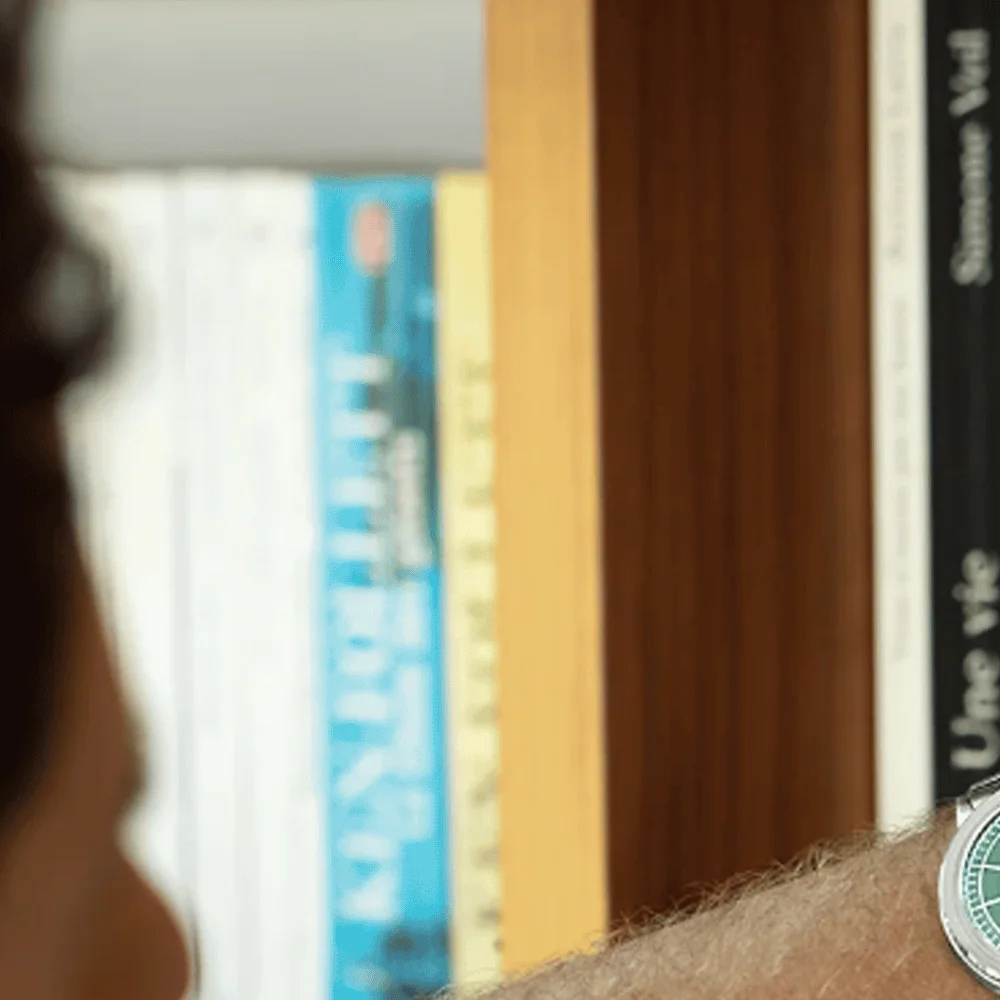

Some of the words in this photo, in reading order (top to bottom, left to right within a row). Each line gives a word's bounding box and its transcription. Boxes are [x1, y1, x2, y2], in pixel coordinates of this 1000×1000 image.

[951, 121, 993, 286] Simone
[952, 549, 1000, 637] vie
[951, 648, 1000, 770] Une
